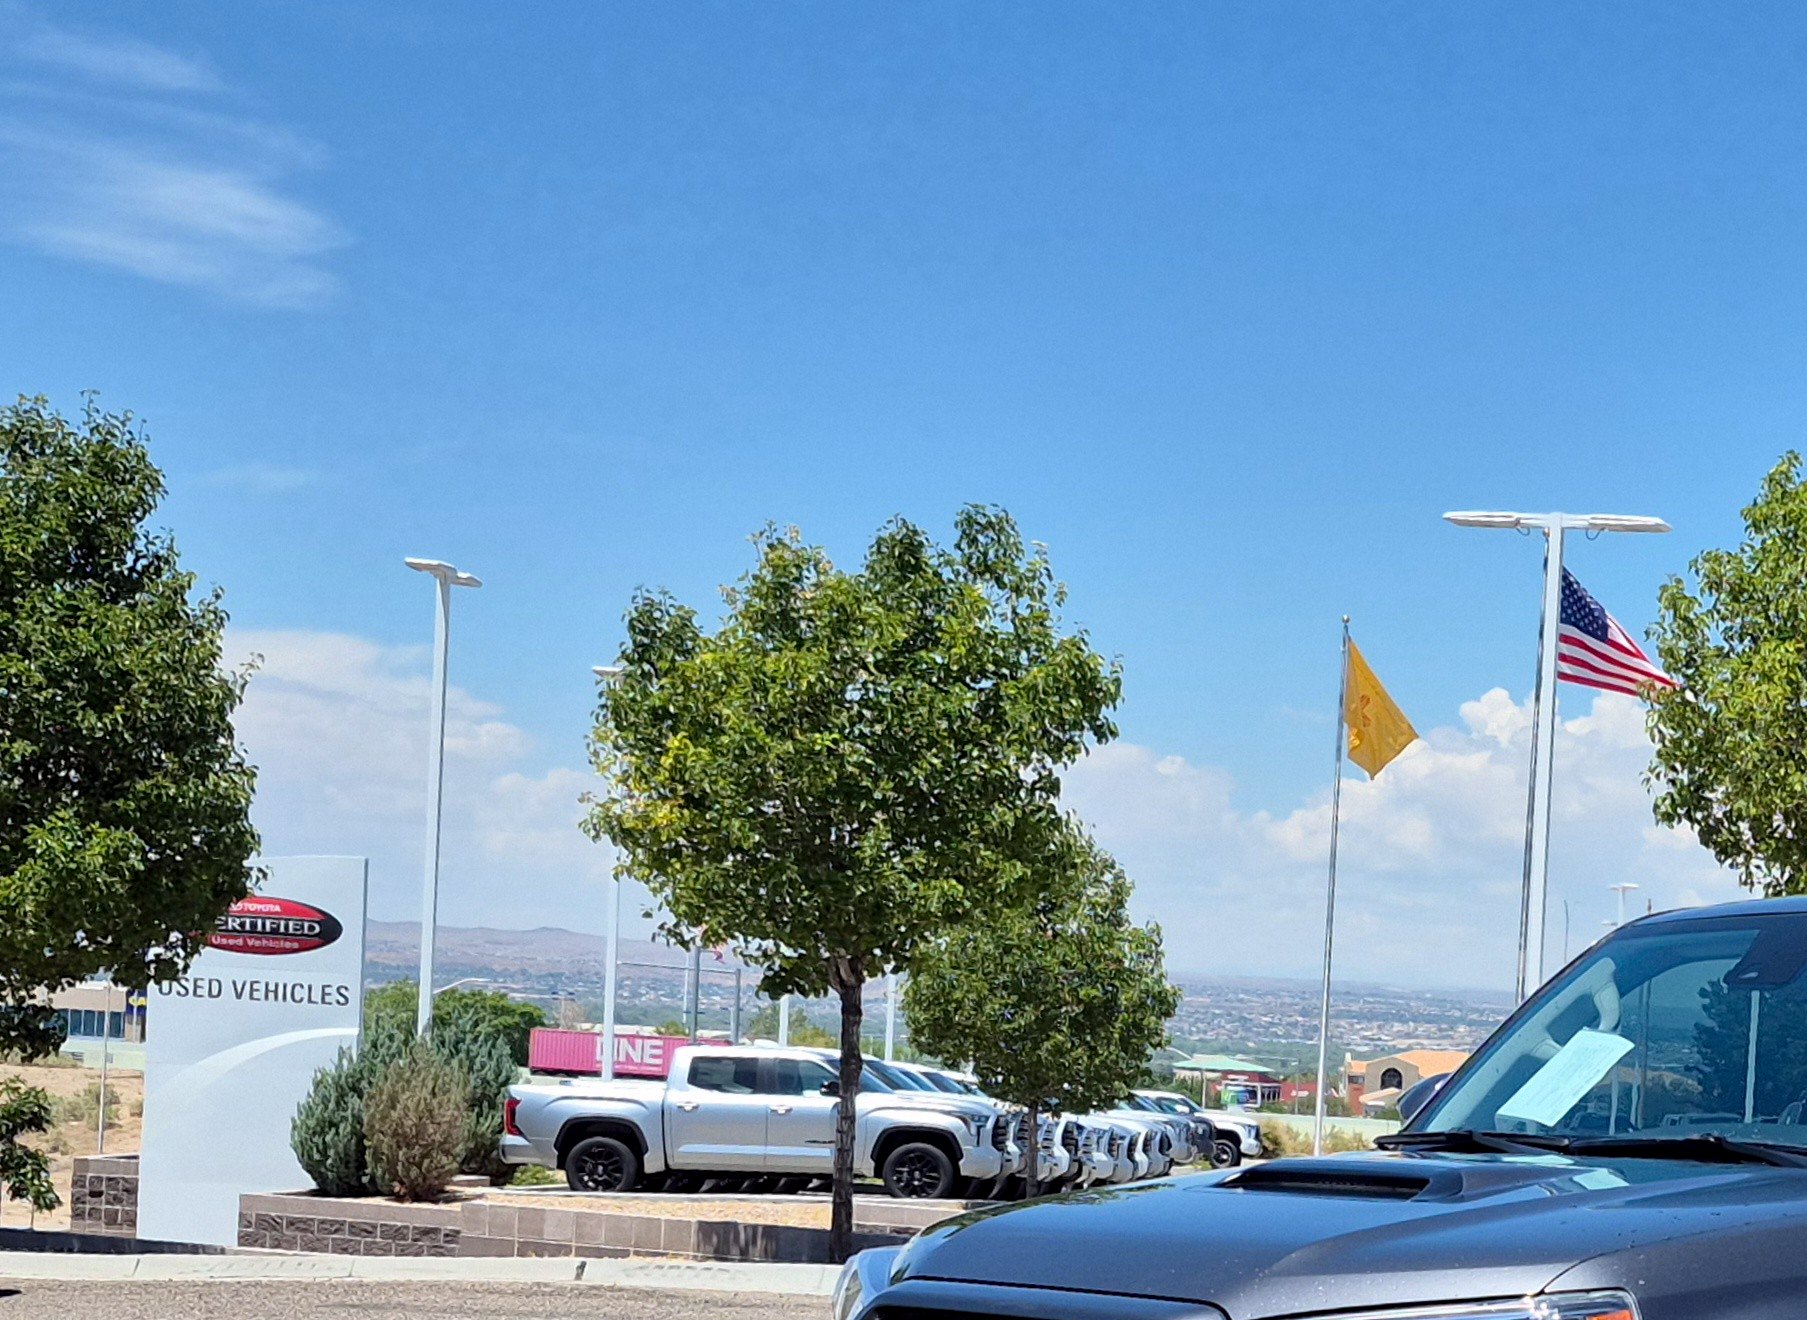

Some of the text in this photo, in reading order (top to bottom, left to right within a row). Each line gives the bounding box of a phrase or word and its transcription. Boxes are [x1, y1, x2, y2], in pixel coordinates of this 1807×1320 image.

[244, 902, 282, 912] TOYOTA
[214, 916, 321, 935] ERTIFIED
[211, 935, 299, 949] Used Vehicles
[158, 976, 350, 1006] USED VEHICLES
